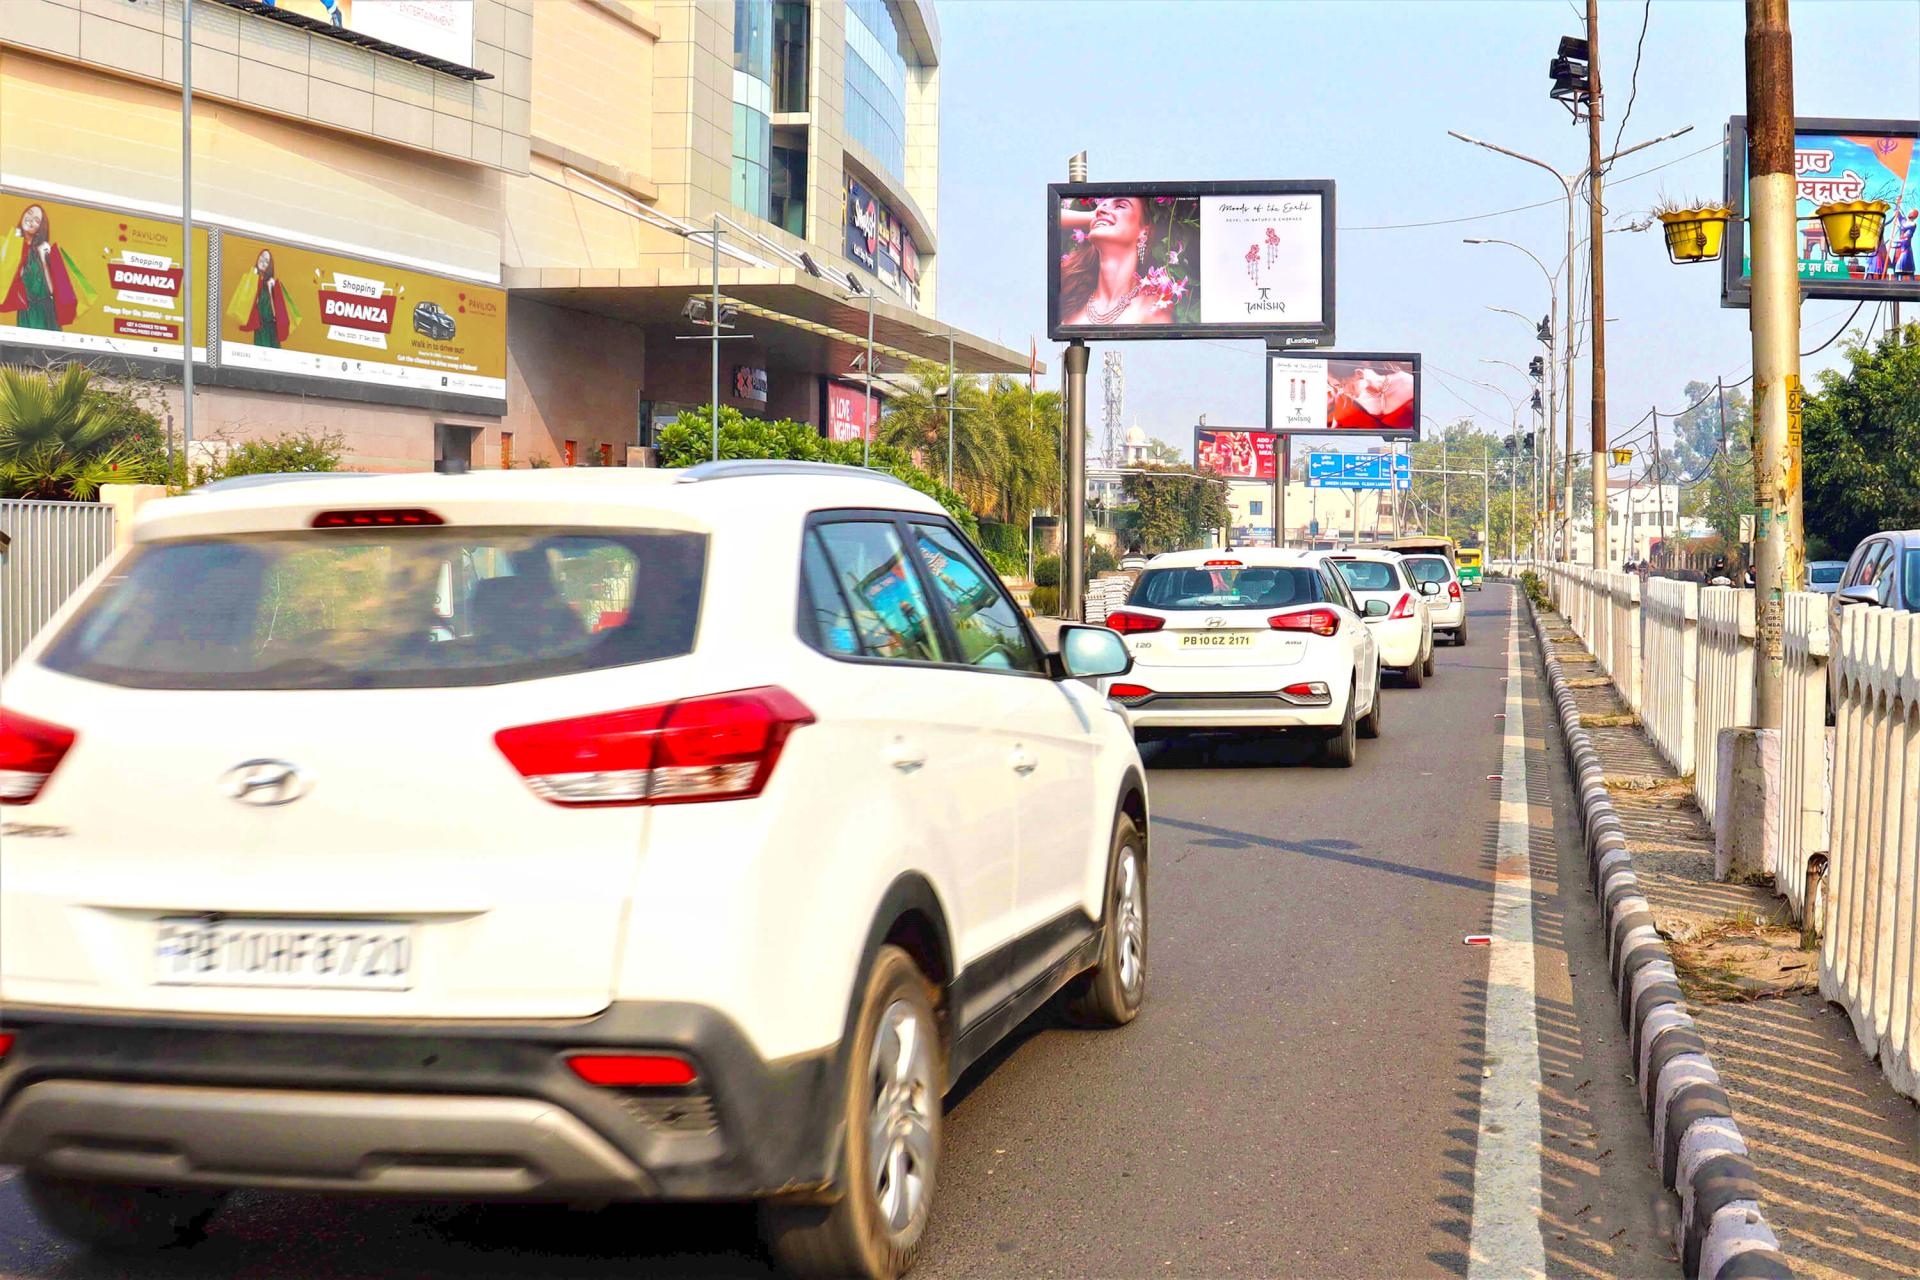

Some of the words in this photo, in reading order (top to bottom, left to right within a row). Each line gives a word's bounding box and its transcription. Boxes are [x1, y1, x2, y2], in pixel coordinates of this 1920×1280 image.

[1219, 203, 1249, 213] Moods
[1253, 204, 1263, 213] of
[1267, 203, 1280, 212] the
[1283, 201, 1312, 213] Earth
[130, 255, 163, 268] Shopping
[114, 270, 175, 290] BONANZA
[342, 280, 376, 296] Shopping
[325, 299, 388, 324] BONANZA
[411, 340, 425, 348] Walk
[439, 343, 453, 352] drive
[1183, 636, 1197, 645] PB
[1199, 636, 1210, 645] 10
[1211, 636, 1225, 645] GZ
[1228, 636, 1250, 645] 2171
